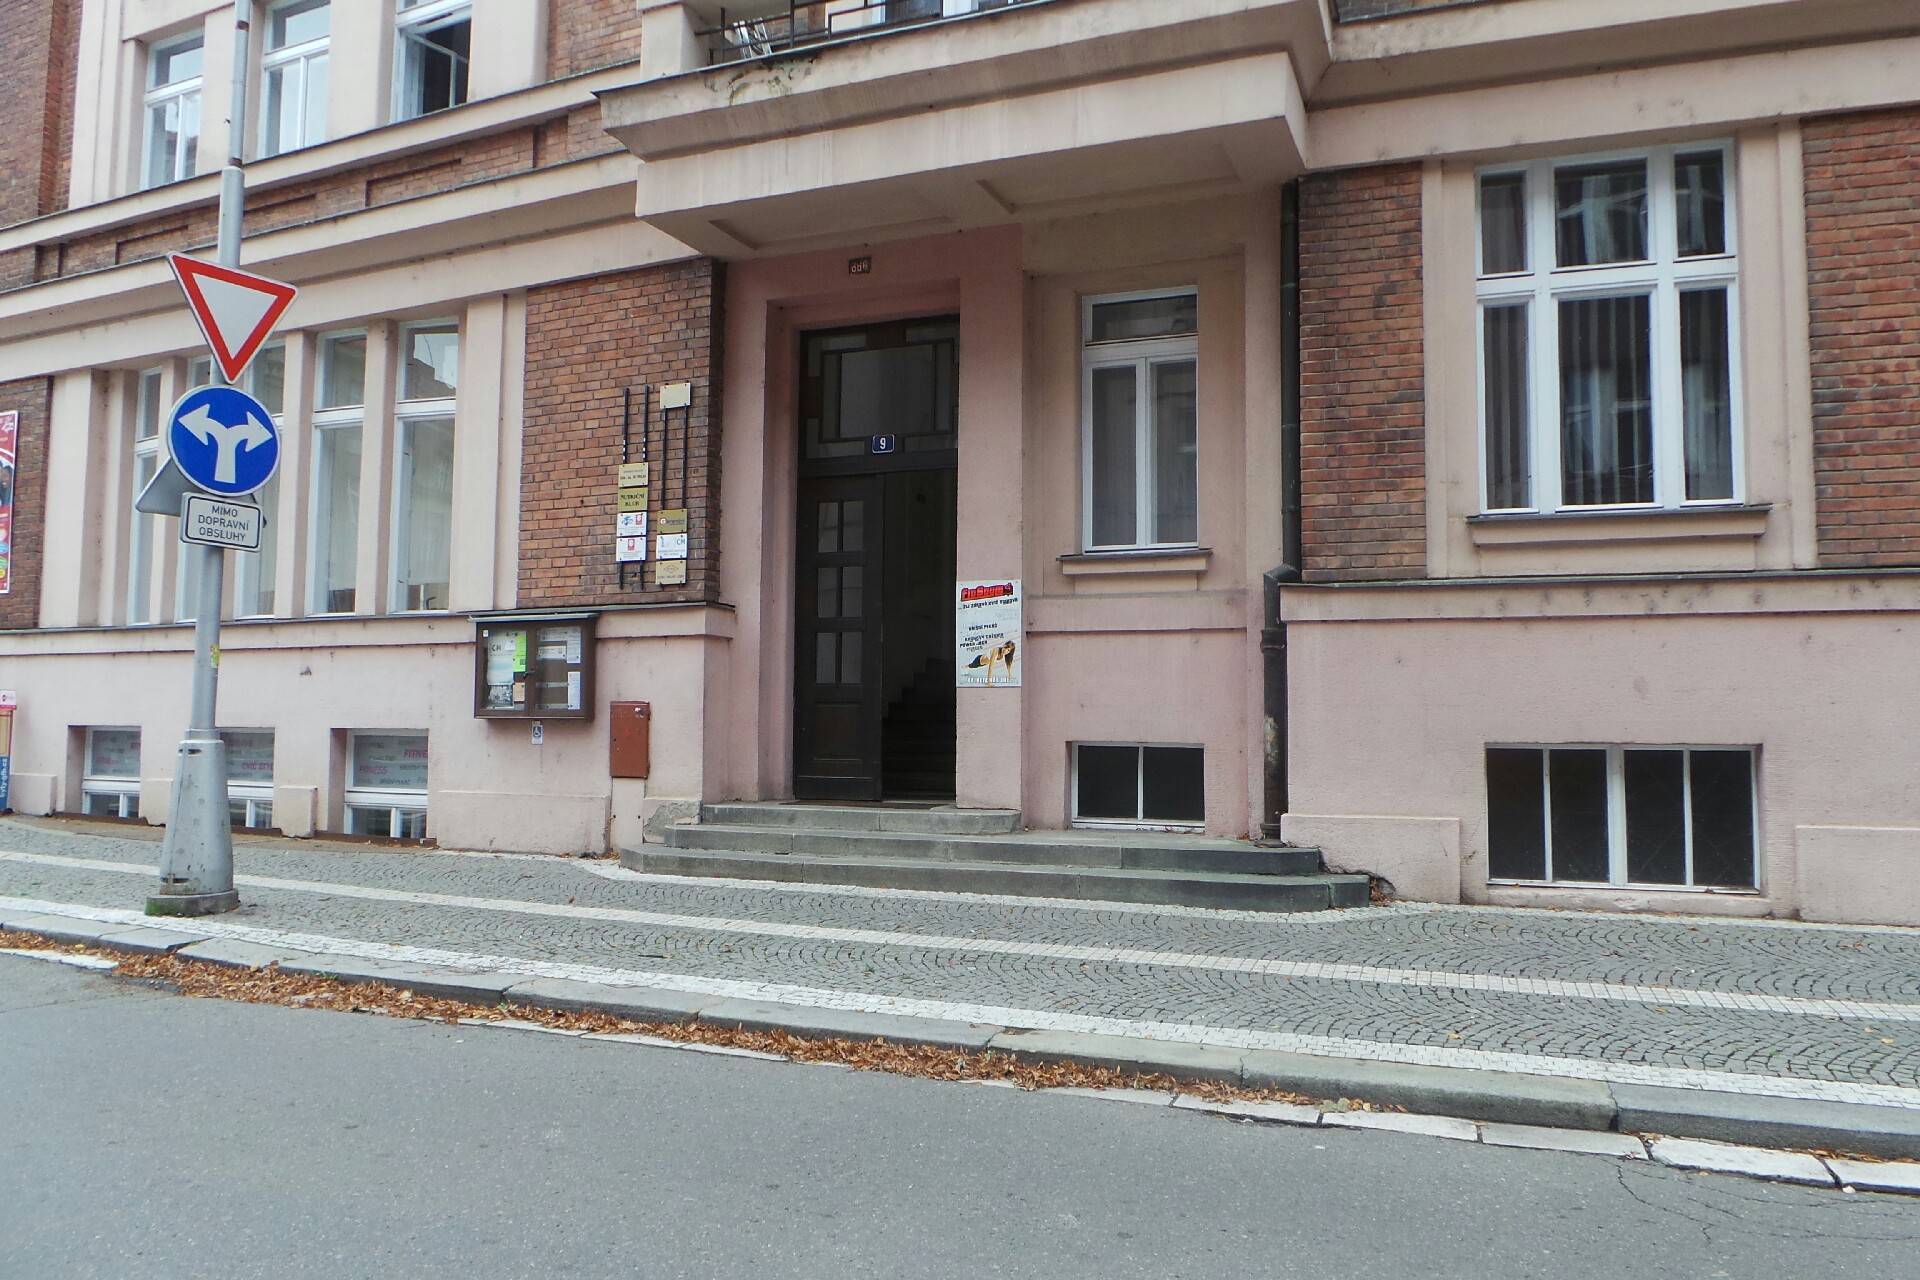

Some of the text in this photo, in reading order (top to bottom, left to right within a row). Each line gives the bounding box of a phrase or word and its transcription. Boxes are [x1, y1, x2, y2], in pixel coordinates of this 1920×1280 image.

[880, 437, 886, 450] 9
[211, 505, 238, 517] MIMO
[198, 514, 249, 531] DOPRAVNÍ
[199, 527, 246, 541] OBSLUHY
